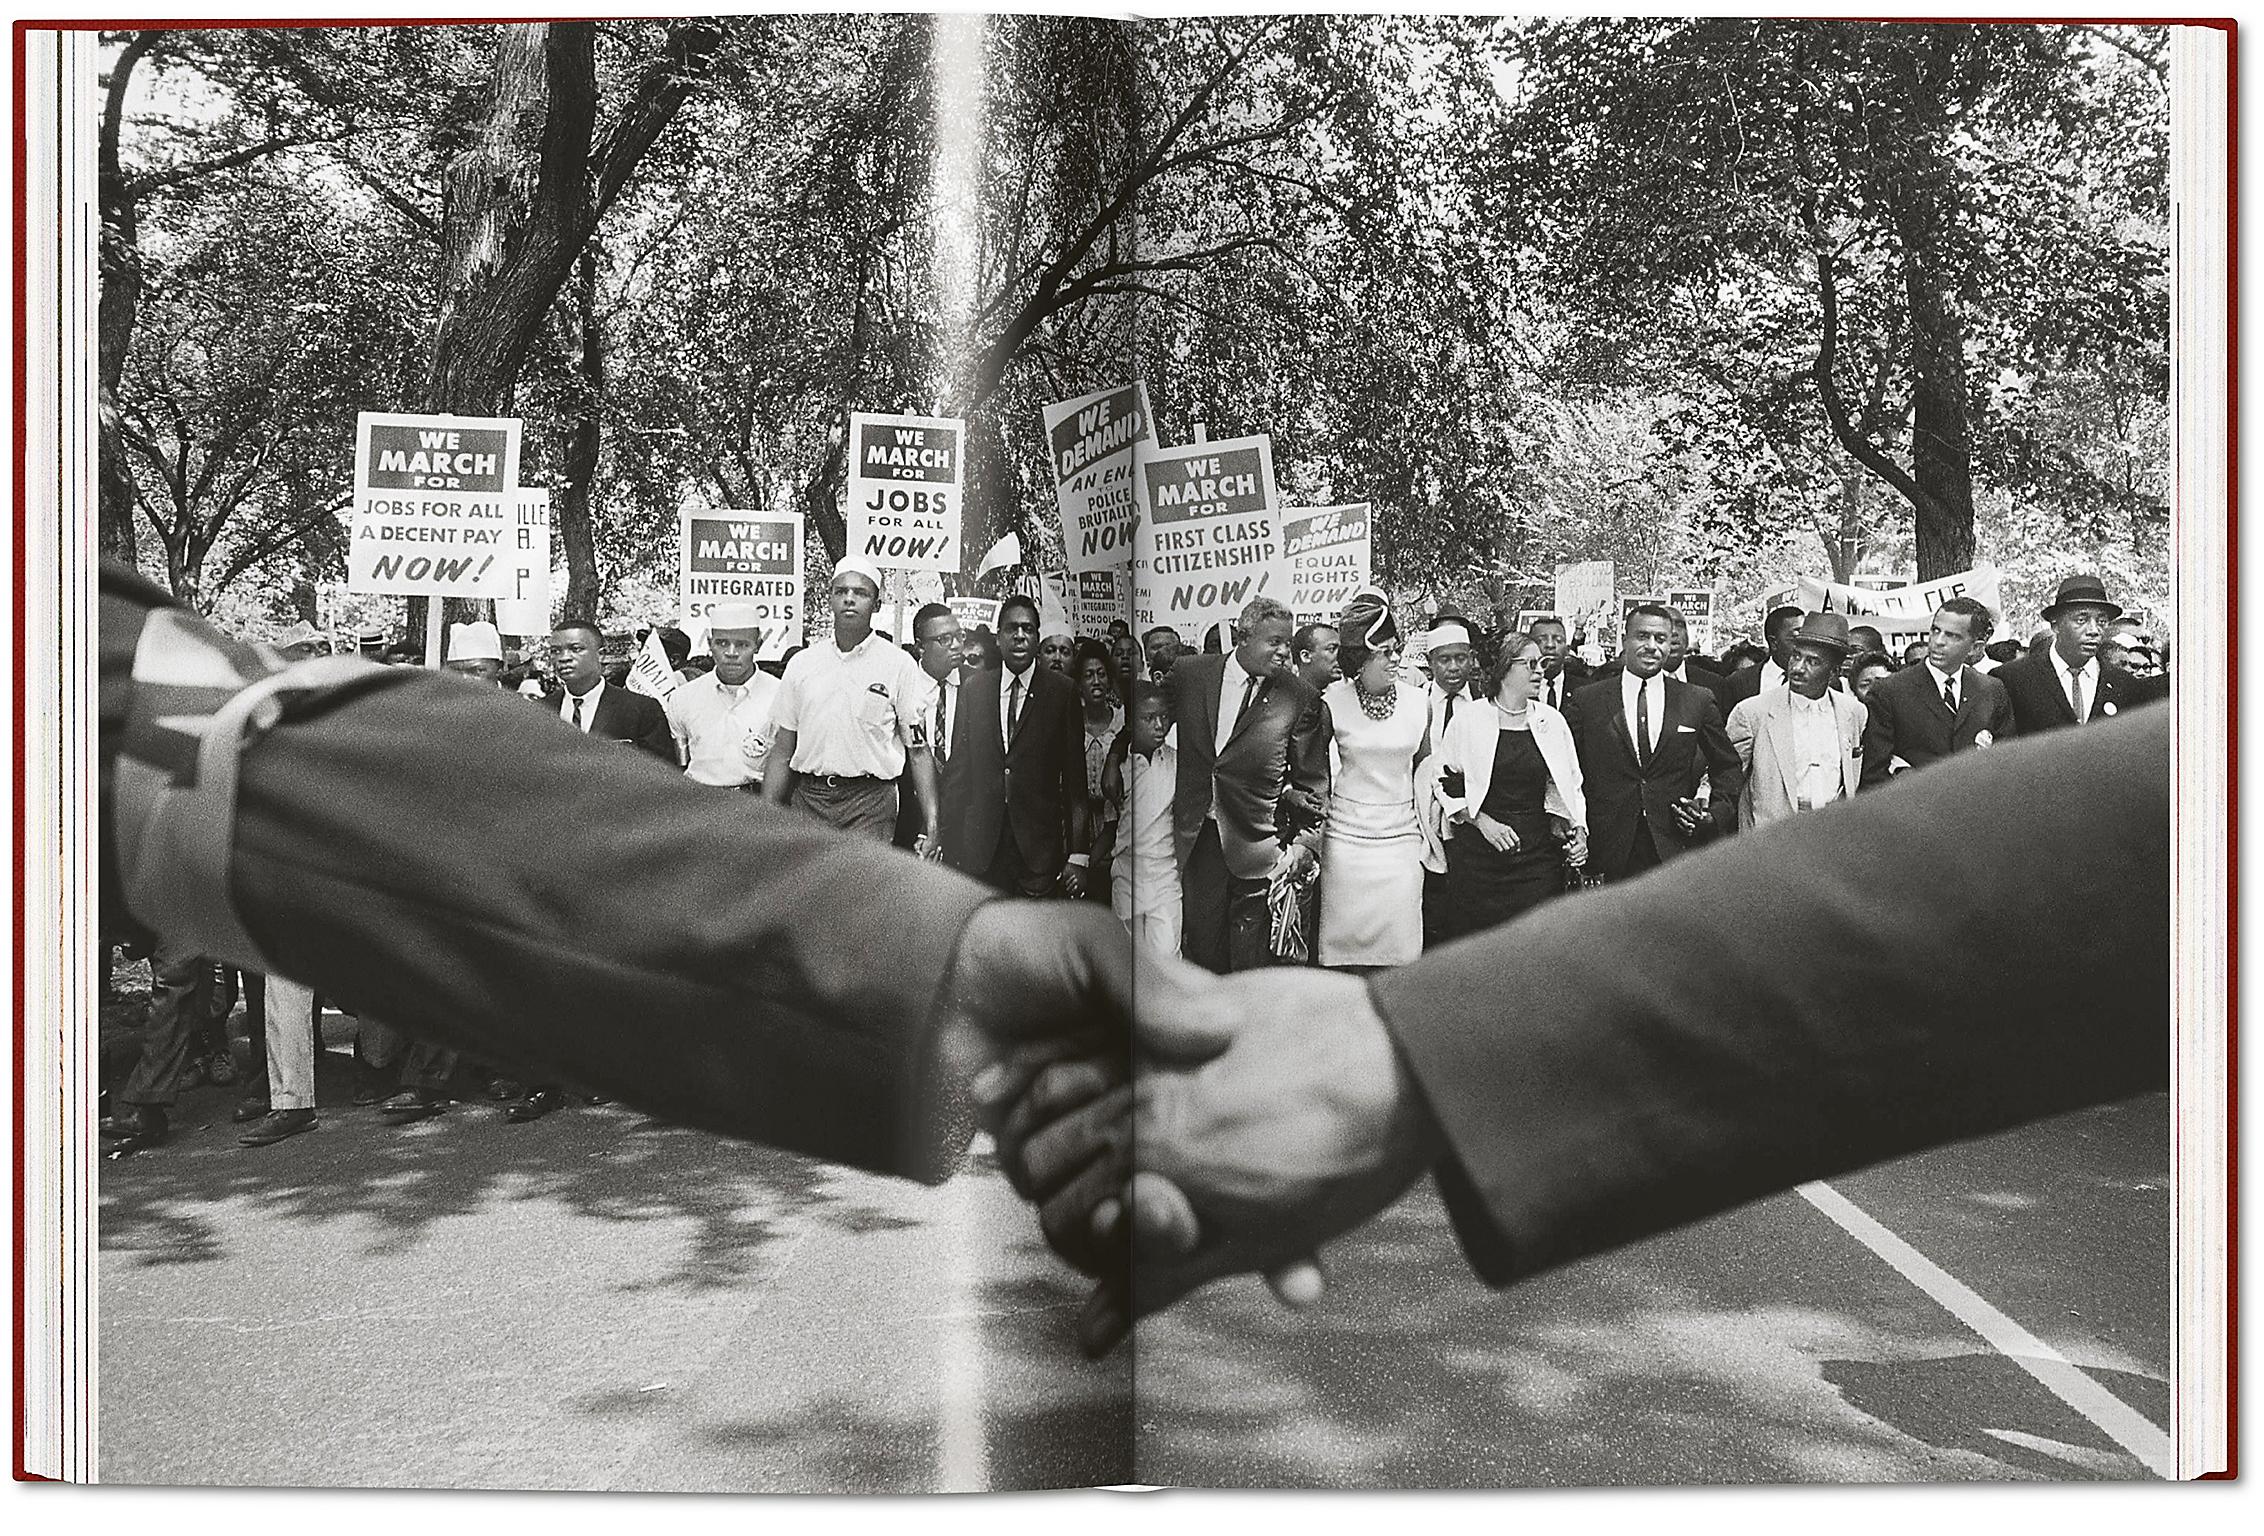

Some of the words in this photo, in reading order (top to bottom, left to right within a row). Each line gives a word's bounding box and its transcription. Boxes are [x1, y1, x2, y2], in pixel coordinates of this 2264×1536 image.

[1079, 399, 1111, 437] WE
[418, 430, 461, 450] WE
[895, 429, 925, 446] WE
[1062, 410, 1142, 476] DEMAND
[378, 450, 496, 475] MARCH
[867, 445, 950, 469] MARCH
[892, 468, 925, 479] FOR
[1184, 457, 1221, 479] WE
[413, 475, 461, 489] FOR
[1072, 473, 1097, 493] AN
[1158, 473, 1256, 507] MARCH
[363, 499, 415, 517] JOBS
[421, 501, 462, 518] FOR
[468, 503, 504, 519] ALL
[866, 489, 947, 515] JOBS
[1088, 488, 1131, 512] POLICE
[1189, 502, 1228, 517] FOR
[728, 523, 761, 540] WE
[868, 516, 902, 527] FOR
[913, 519, 944, 530] ALL
[1310, 512, 1342, 534] WE
[359, 525, 376, 540] A
[380, 526, 457, 543] DECENT
[463, 529, 503, 544] PAY
[1154, 528, 1205, 551] FIRST
[1212, 520, 1271, 544] CLASS
[1287, 521, 1365, 555] DEMAND
[698, 540, 788, 560] MARCH
[865, 534, 949, 559] NOW!
[372, 554, 494, 583] NOW!
[726, 561, 762, 572] FOR
[1153, 543, 1276, 575] CITIZENSHIP
[1295, 554, 1358, 569] EQUAL
[1091, 572, 1102, 581] WE
[1293, 570, 1360, 584] RIGHTS
[690, 579, 795, 596] INTEGRATED
[1082, 582, 1112, 593] MARCH
[1170, 571, 1270, 612] NOW!
[1291, 584, 1362, 605] NOW!
[690, 603, 794, 620] SCOLS
[951, 607, 993, 619] MARCH
[1081, 602, 1116, 612] INTEGRATED
[1673, 601, 1708, 610] MARCH
